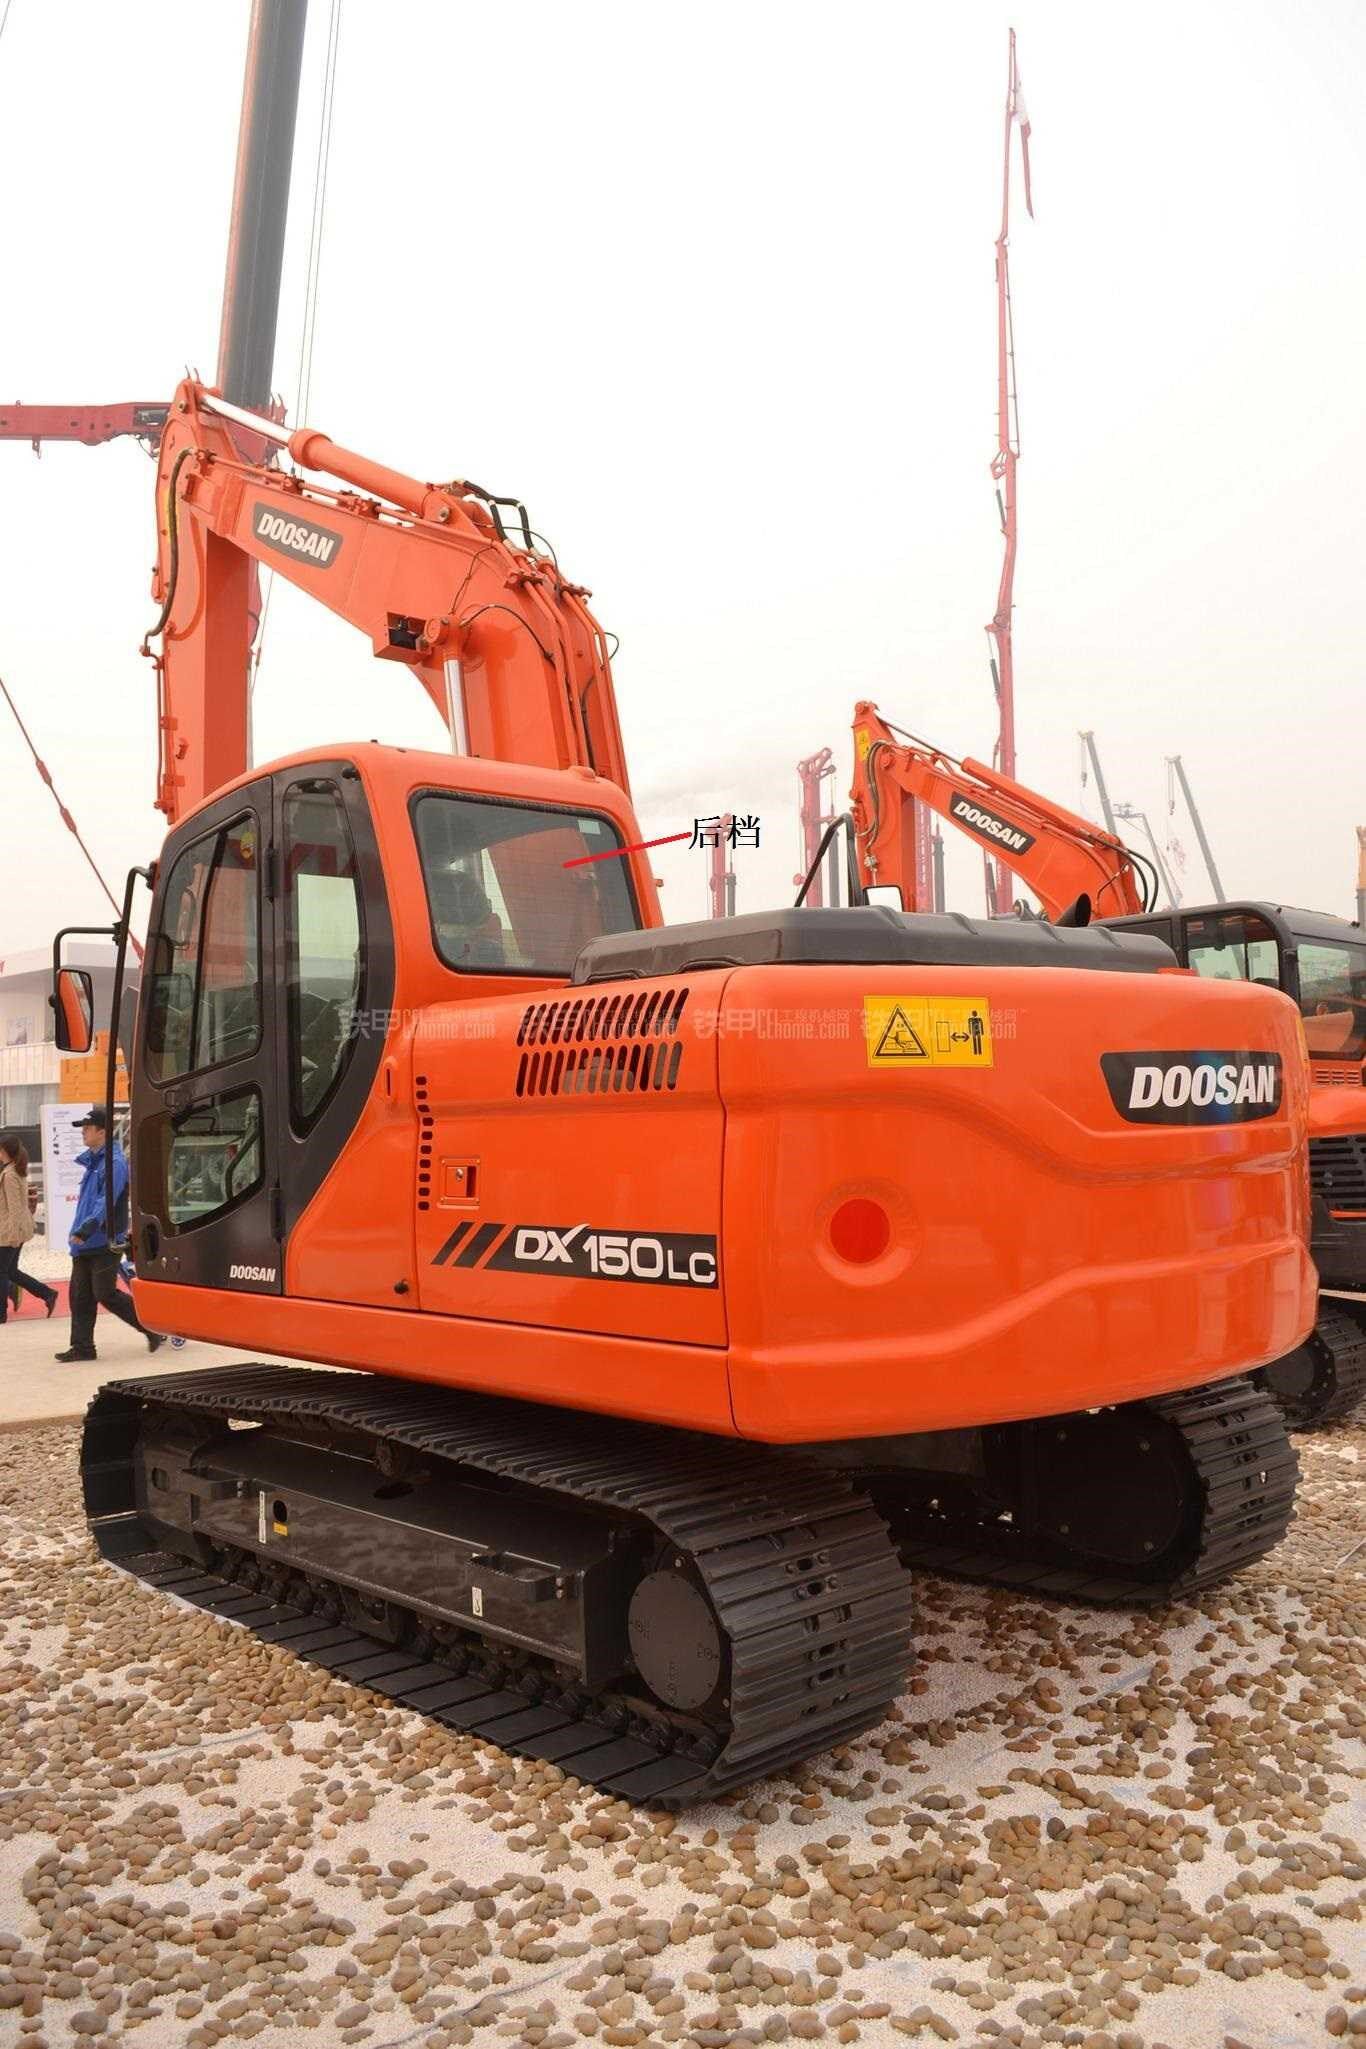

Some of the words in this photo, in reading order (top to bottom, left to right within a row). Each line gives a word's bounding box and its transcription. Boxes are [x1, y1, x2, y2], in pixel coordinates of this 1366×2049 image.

[257, 512, 335, 562] DOOSAN
[953, 800, 1028, 850] DOOSAN
[1128, 1064, 1275, 1109] DOOSAN
[229, 1264, 276, 1283] DOOSAN
